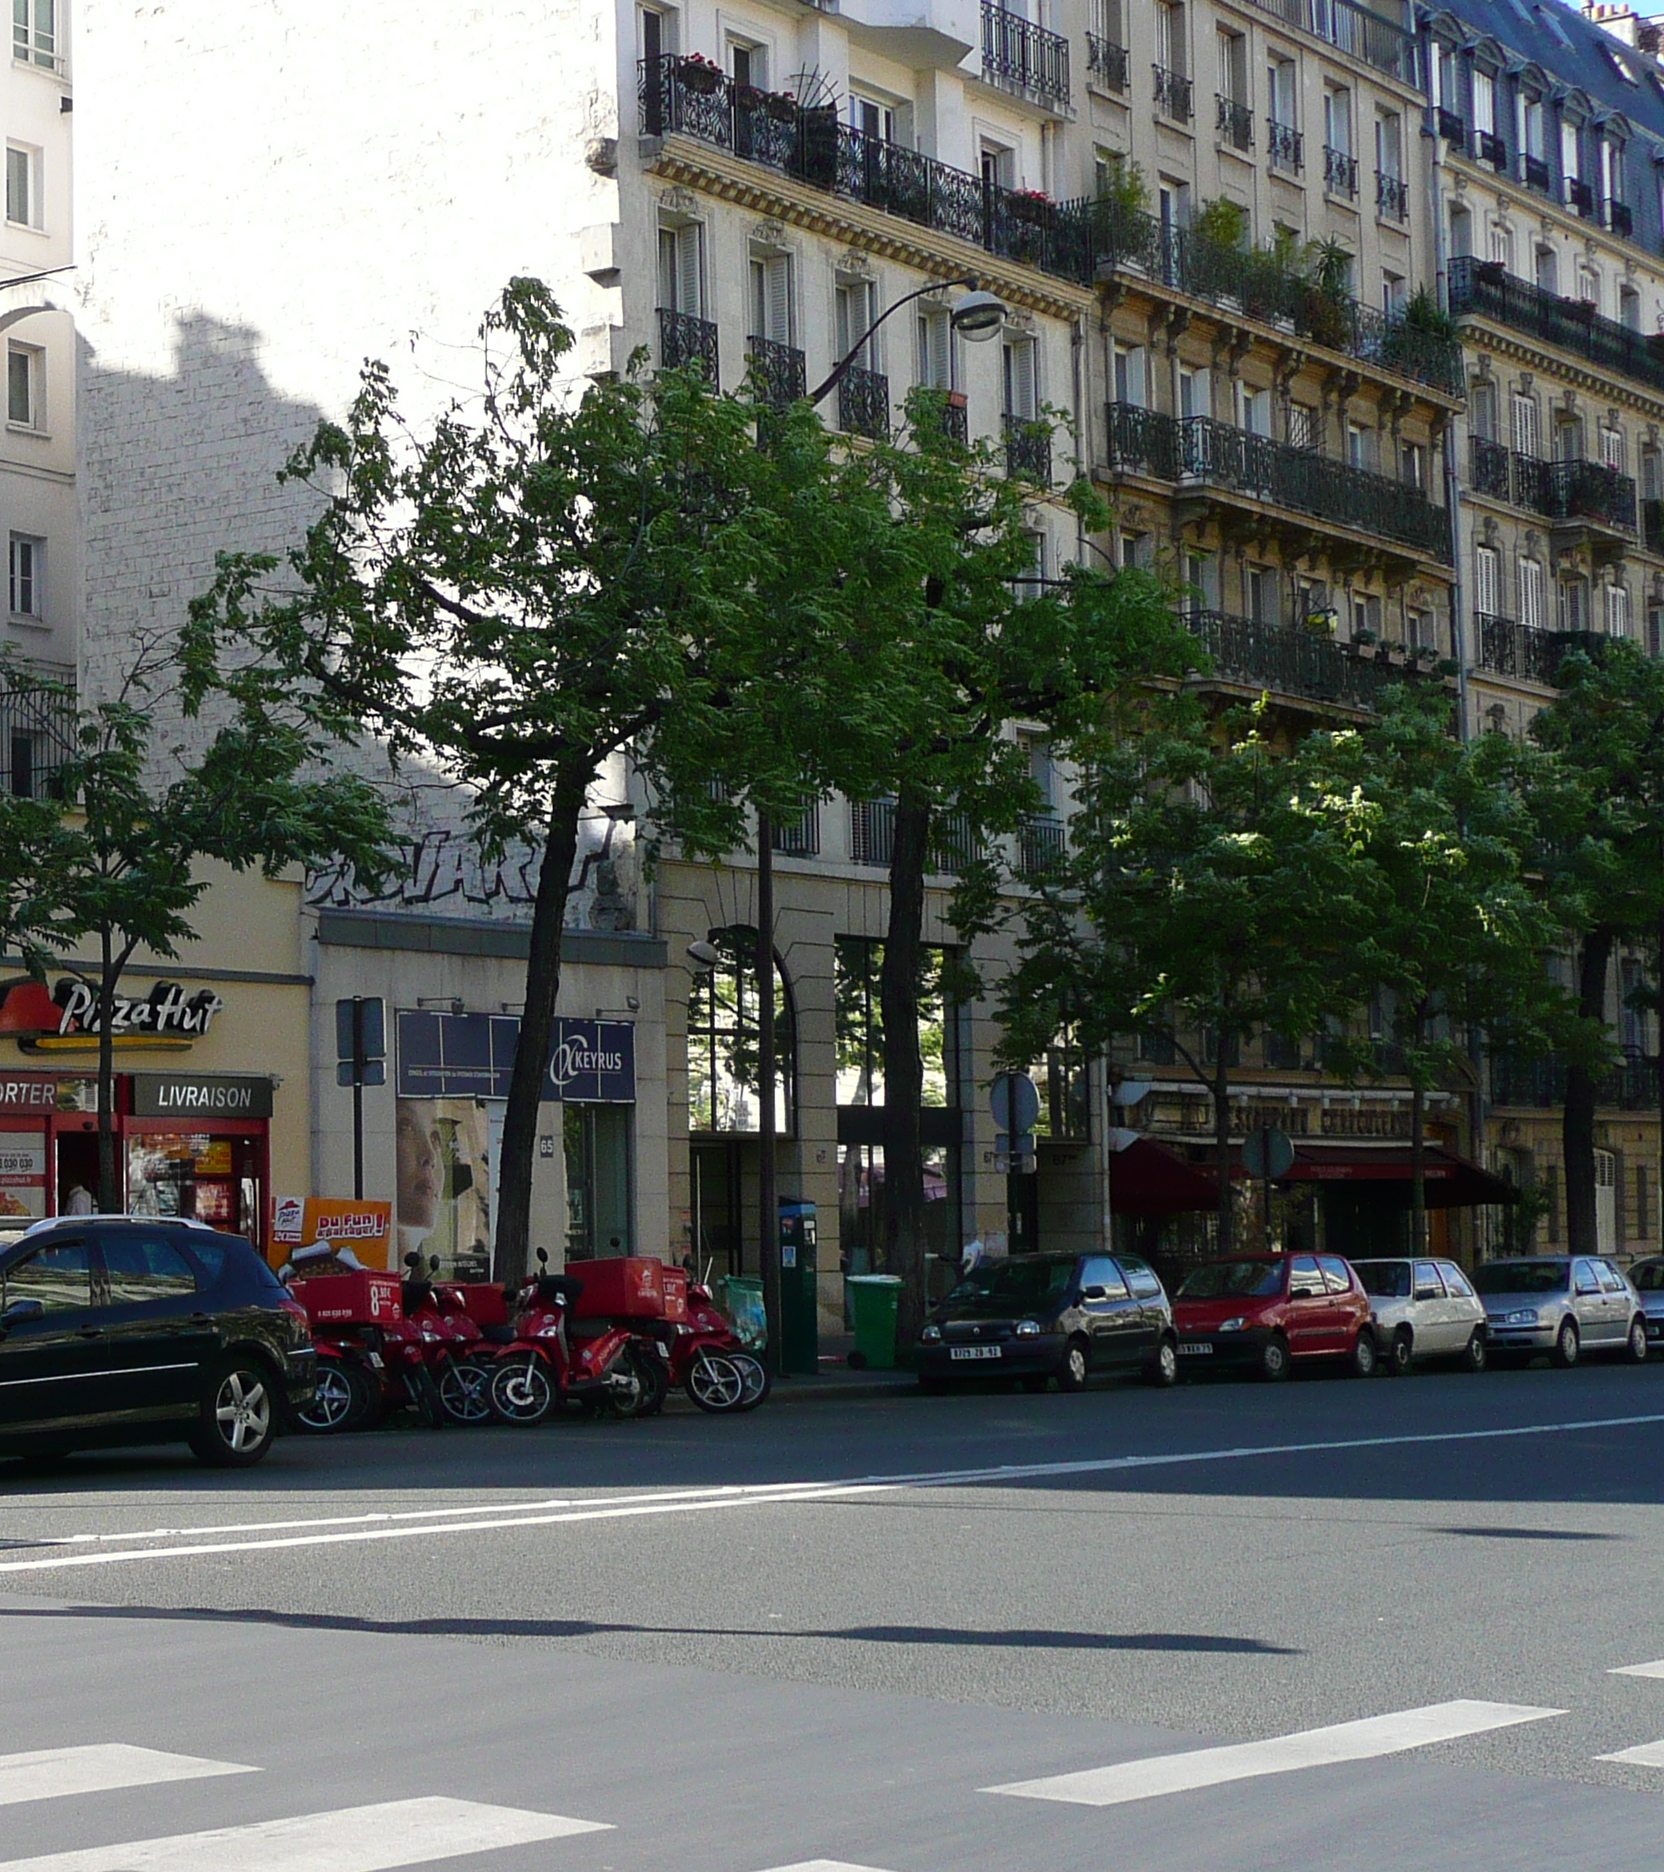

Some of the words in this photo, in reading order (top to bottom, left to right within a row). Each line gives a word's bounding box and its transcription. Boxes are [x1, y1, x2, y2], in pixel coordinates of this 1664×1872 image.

[157, 983, 223, 1034] Hut
[576, 1051, 622, 1070] KEYRUS
[158, 1085, 251, 1108] LIVRAISON
[541, 1139, 553, 1153] 65
[318, 1215, 341, 1229] Du
